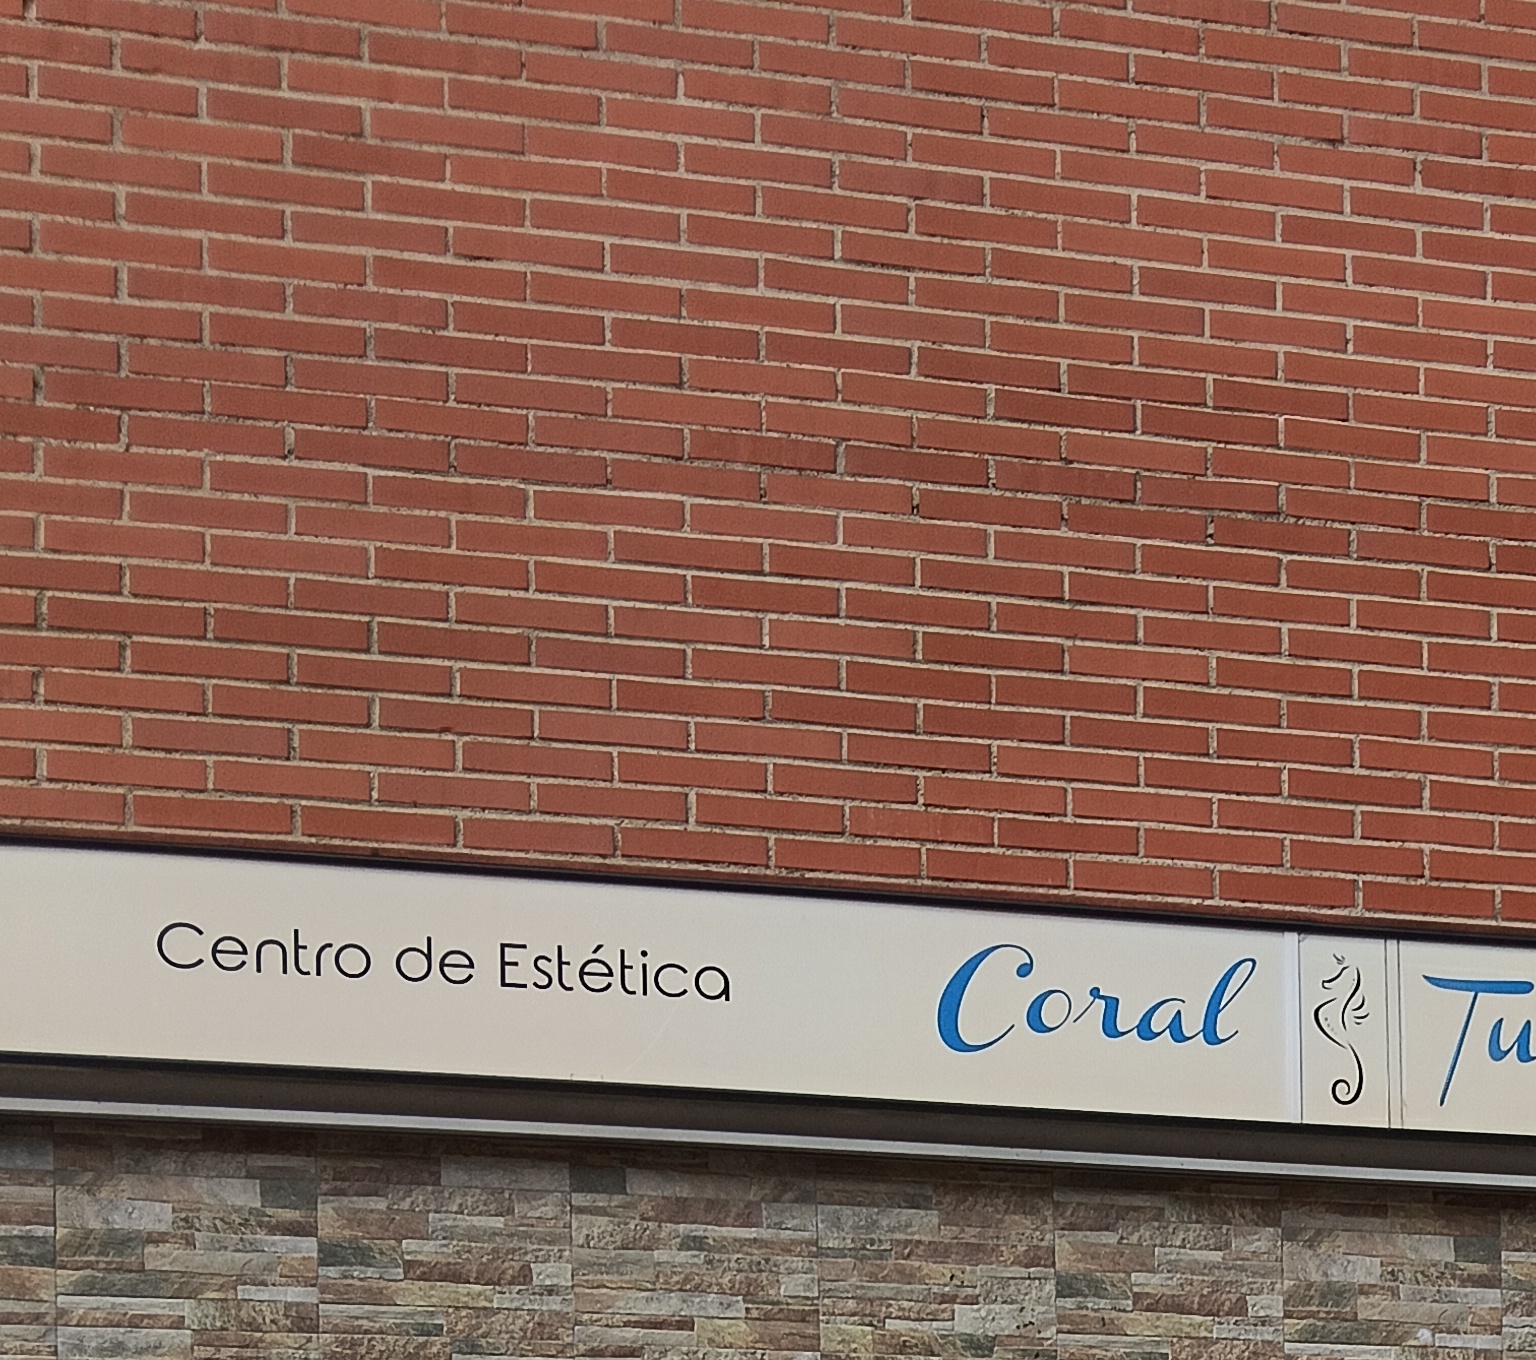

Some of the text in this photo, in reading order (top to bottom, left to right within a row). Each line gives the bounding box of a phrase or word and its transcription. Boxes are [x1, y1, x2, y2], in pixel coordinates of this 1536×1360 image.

[156, 921, 732, 1002] Centro de Estética
[936, 943, 1258, 1054] Coral
